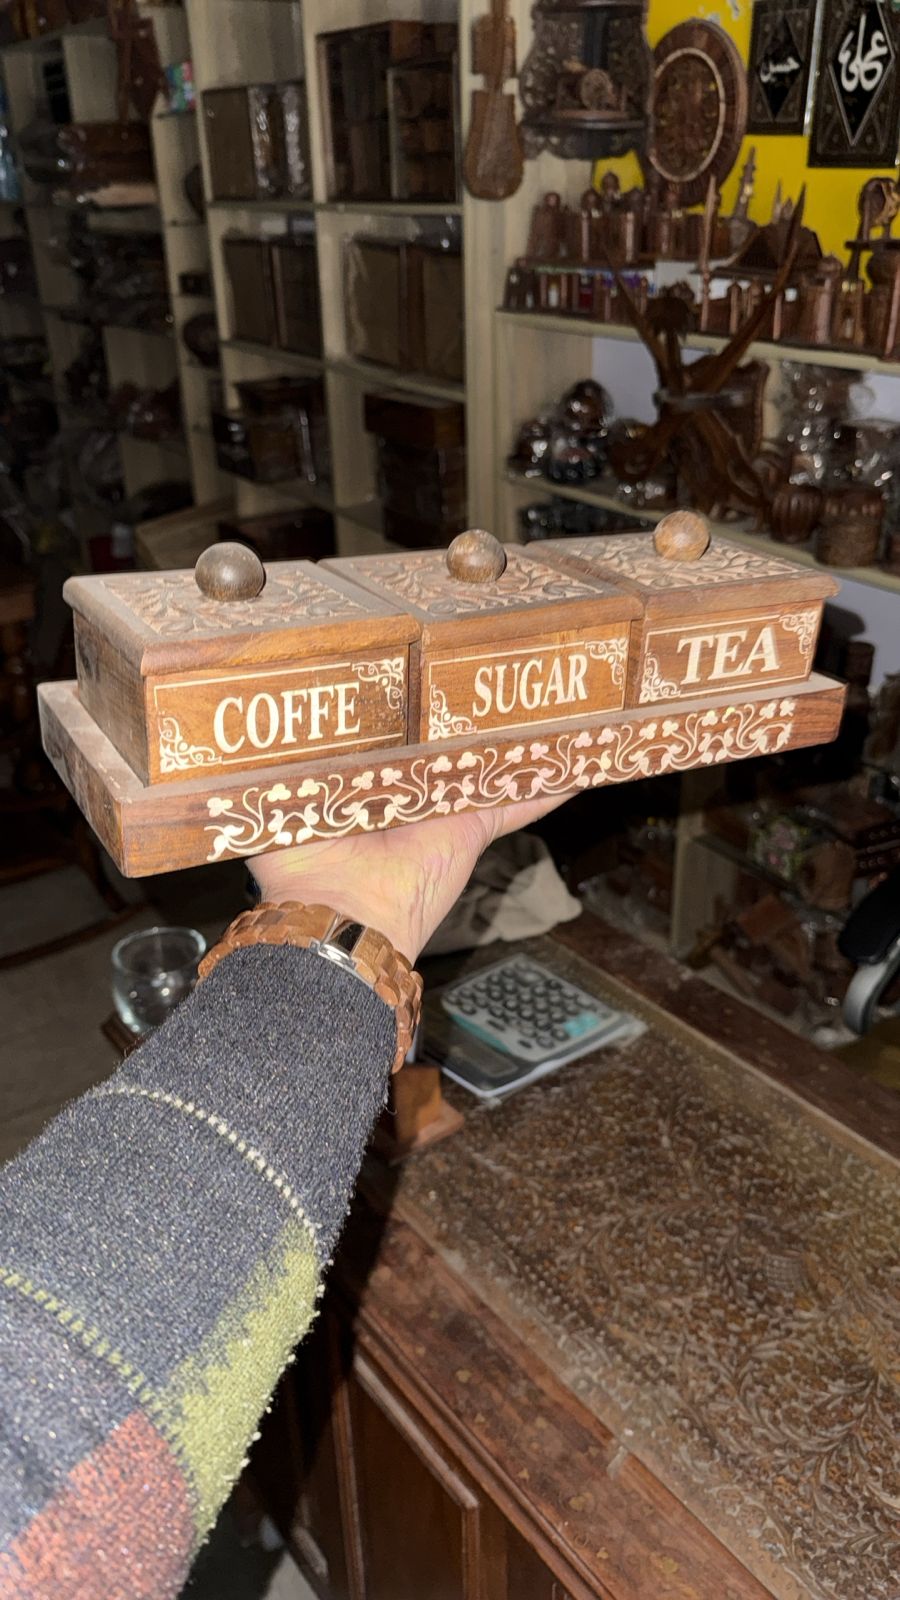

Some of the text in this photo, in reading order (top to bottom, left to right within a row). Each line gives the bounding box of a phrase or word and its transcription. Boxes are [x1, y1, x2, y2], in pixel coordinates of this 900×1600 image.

[472, 654, 589, 718] SUGAR
[677, 625, 780, 686] TEA
[213, 682, 361, 754] COFFE
